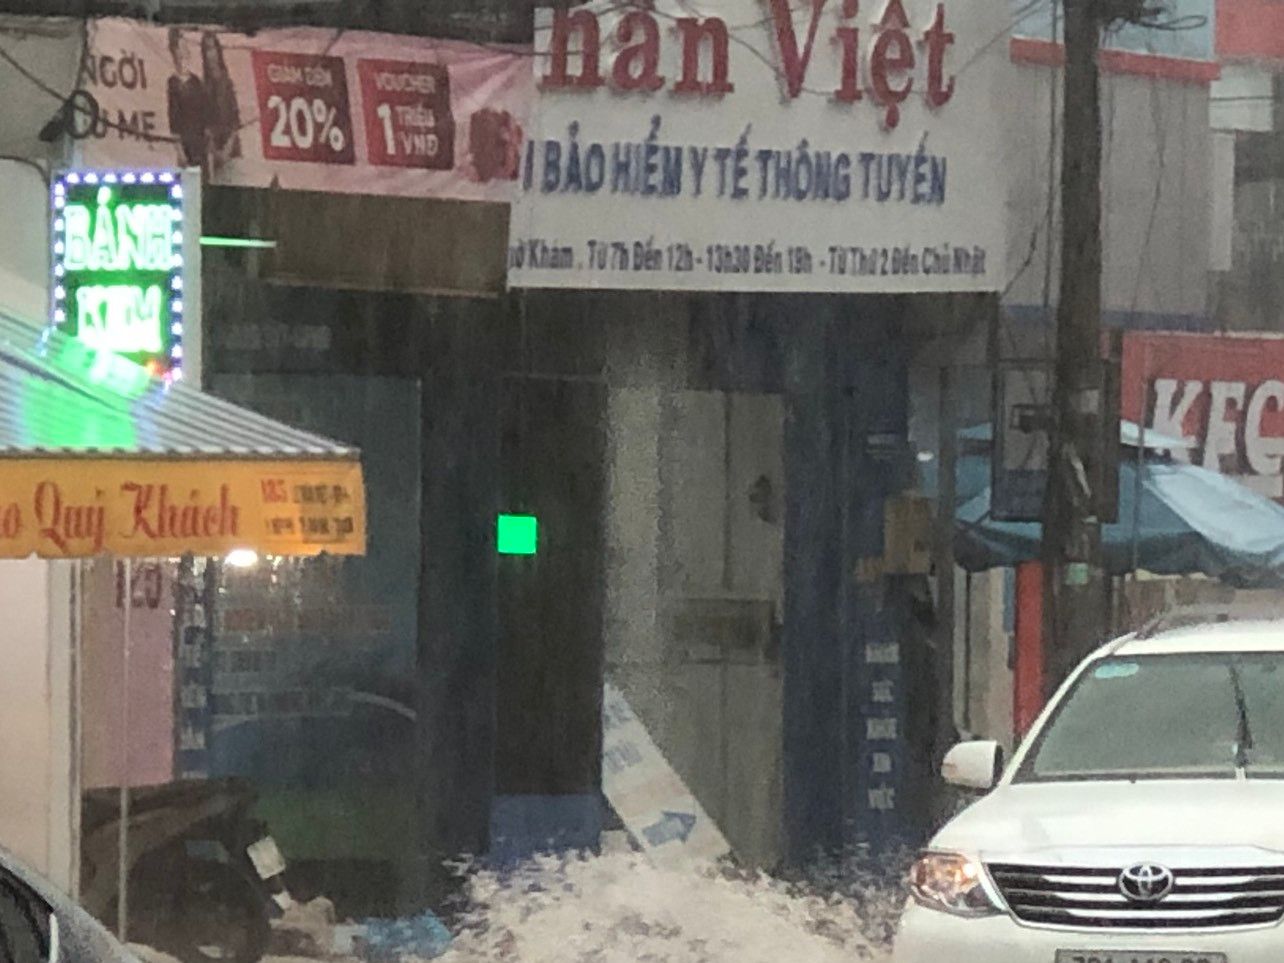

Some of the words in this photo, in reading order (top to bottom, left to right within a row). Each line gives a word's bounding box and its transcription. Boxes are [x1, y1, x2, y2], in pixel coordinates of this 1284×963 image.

[375, 71, 437, 94] VOUCHER
[764, 0, 956, 129] Việt
[267, 95, 345, 152] 20%
[376, 103, 396, 155] 1
[689, 146, 709, 197] Y
[712, 123, 752, 198] TẾ
[756, 138, 851, 202] THÔNG
[119, 482, 240, 539] Khách
